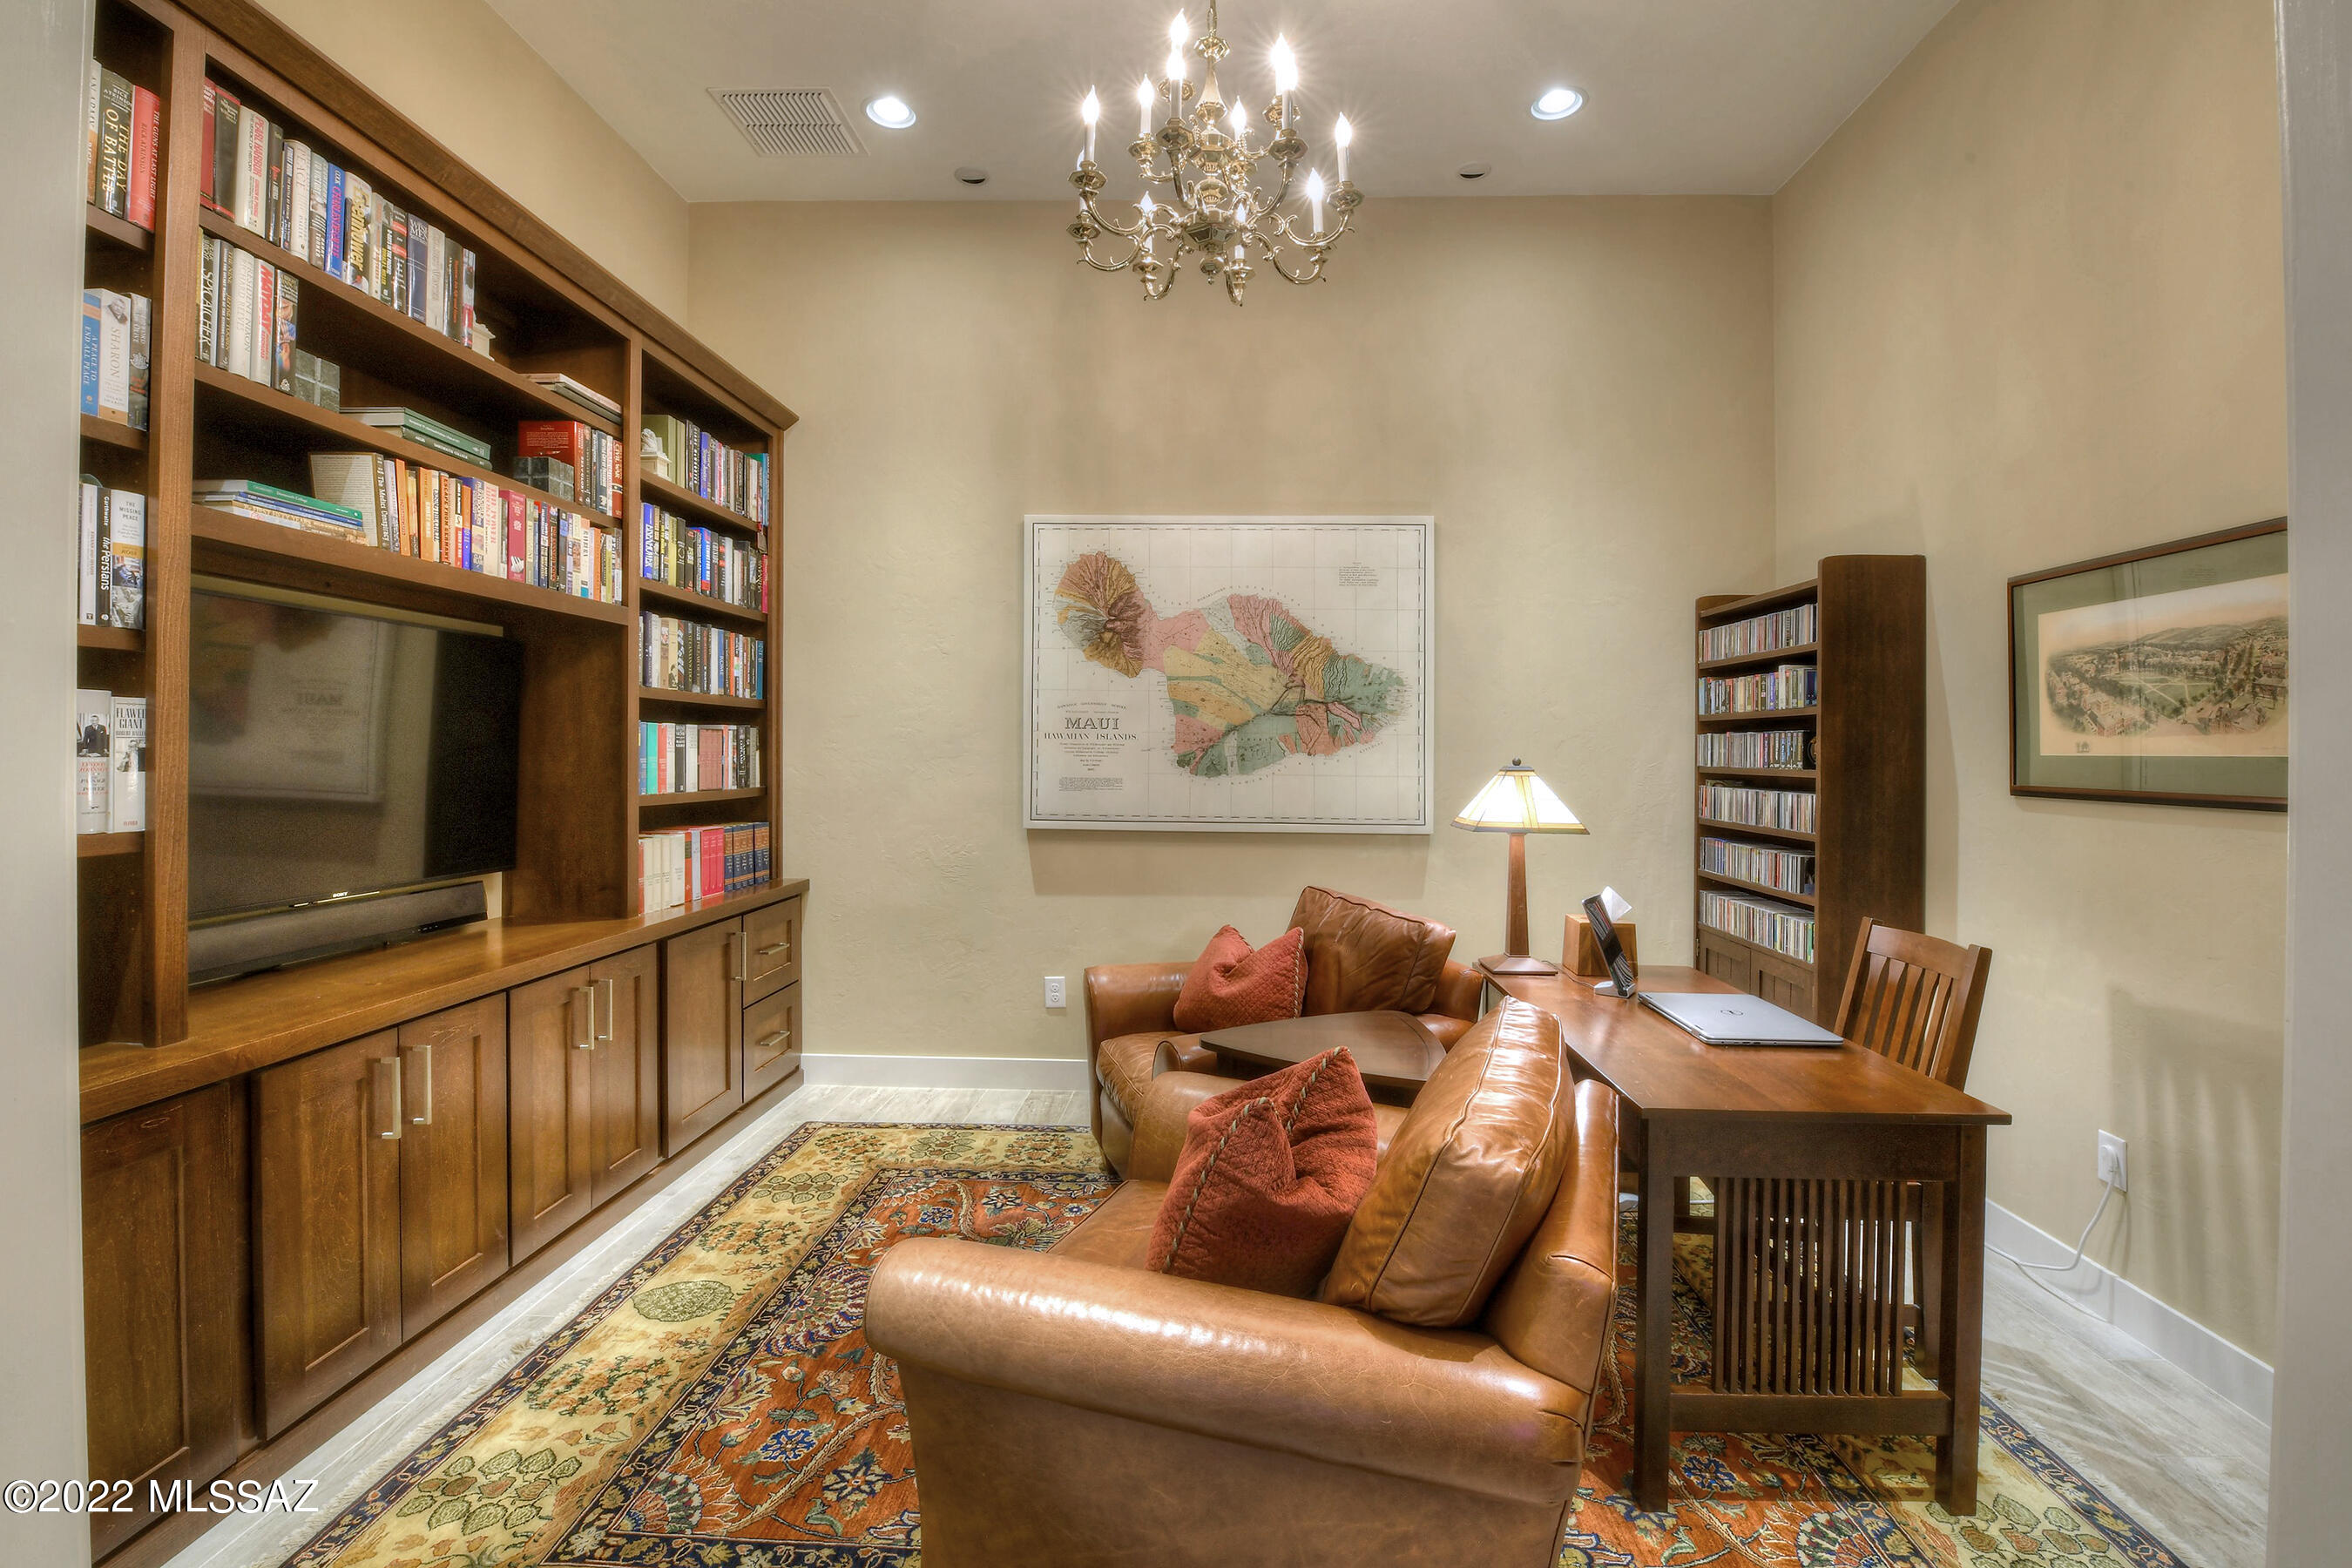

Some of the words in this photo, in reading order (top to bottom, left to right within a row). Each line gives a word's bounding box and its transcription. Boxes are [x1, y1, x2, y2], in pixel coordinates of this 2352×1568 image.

[104, 89, 131, 105] ATKINSO
[113, 89, 127, 98] RICK
[105, 108, 118, 132] OF
[253, 117, 265, 143] PEARL
[118, 125, 129, 153] THE
[103, 134, 117, 193] BATTLE
[152, 149, 159, 160] AT
[253, 142, 263, 177] HARBOR
[116, 159, 127, 193] DAY
[261, 265, 274, 335] MAYDAY
[112, 328, 120, 378] SHARON
[91, 369, 98, 382] TO
[101, 551, 112, 591] Persians
[120, 719, 143, 728] GIANT
[1064, 718, 1119, 730] MAUI
